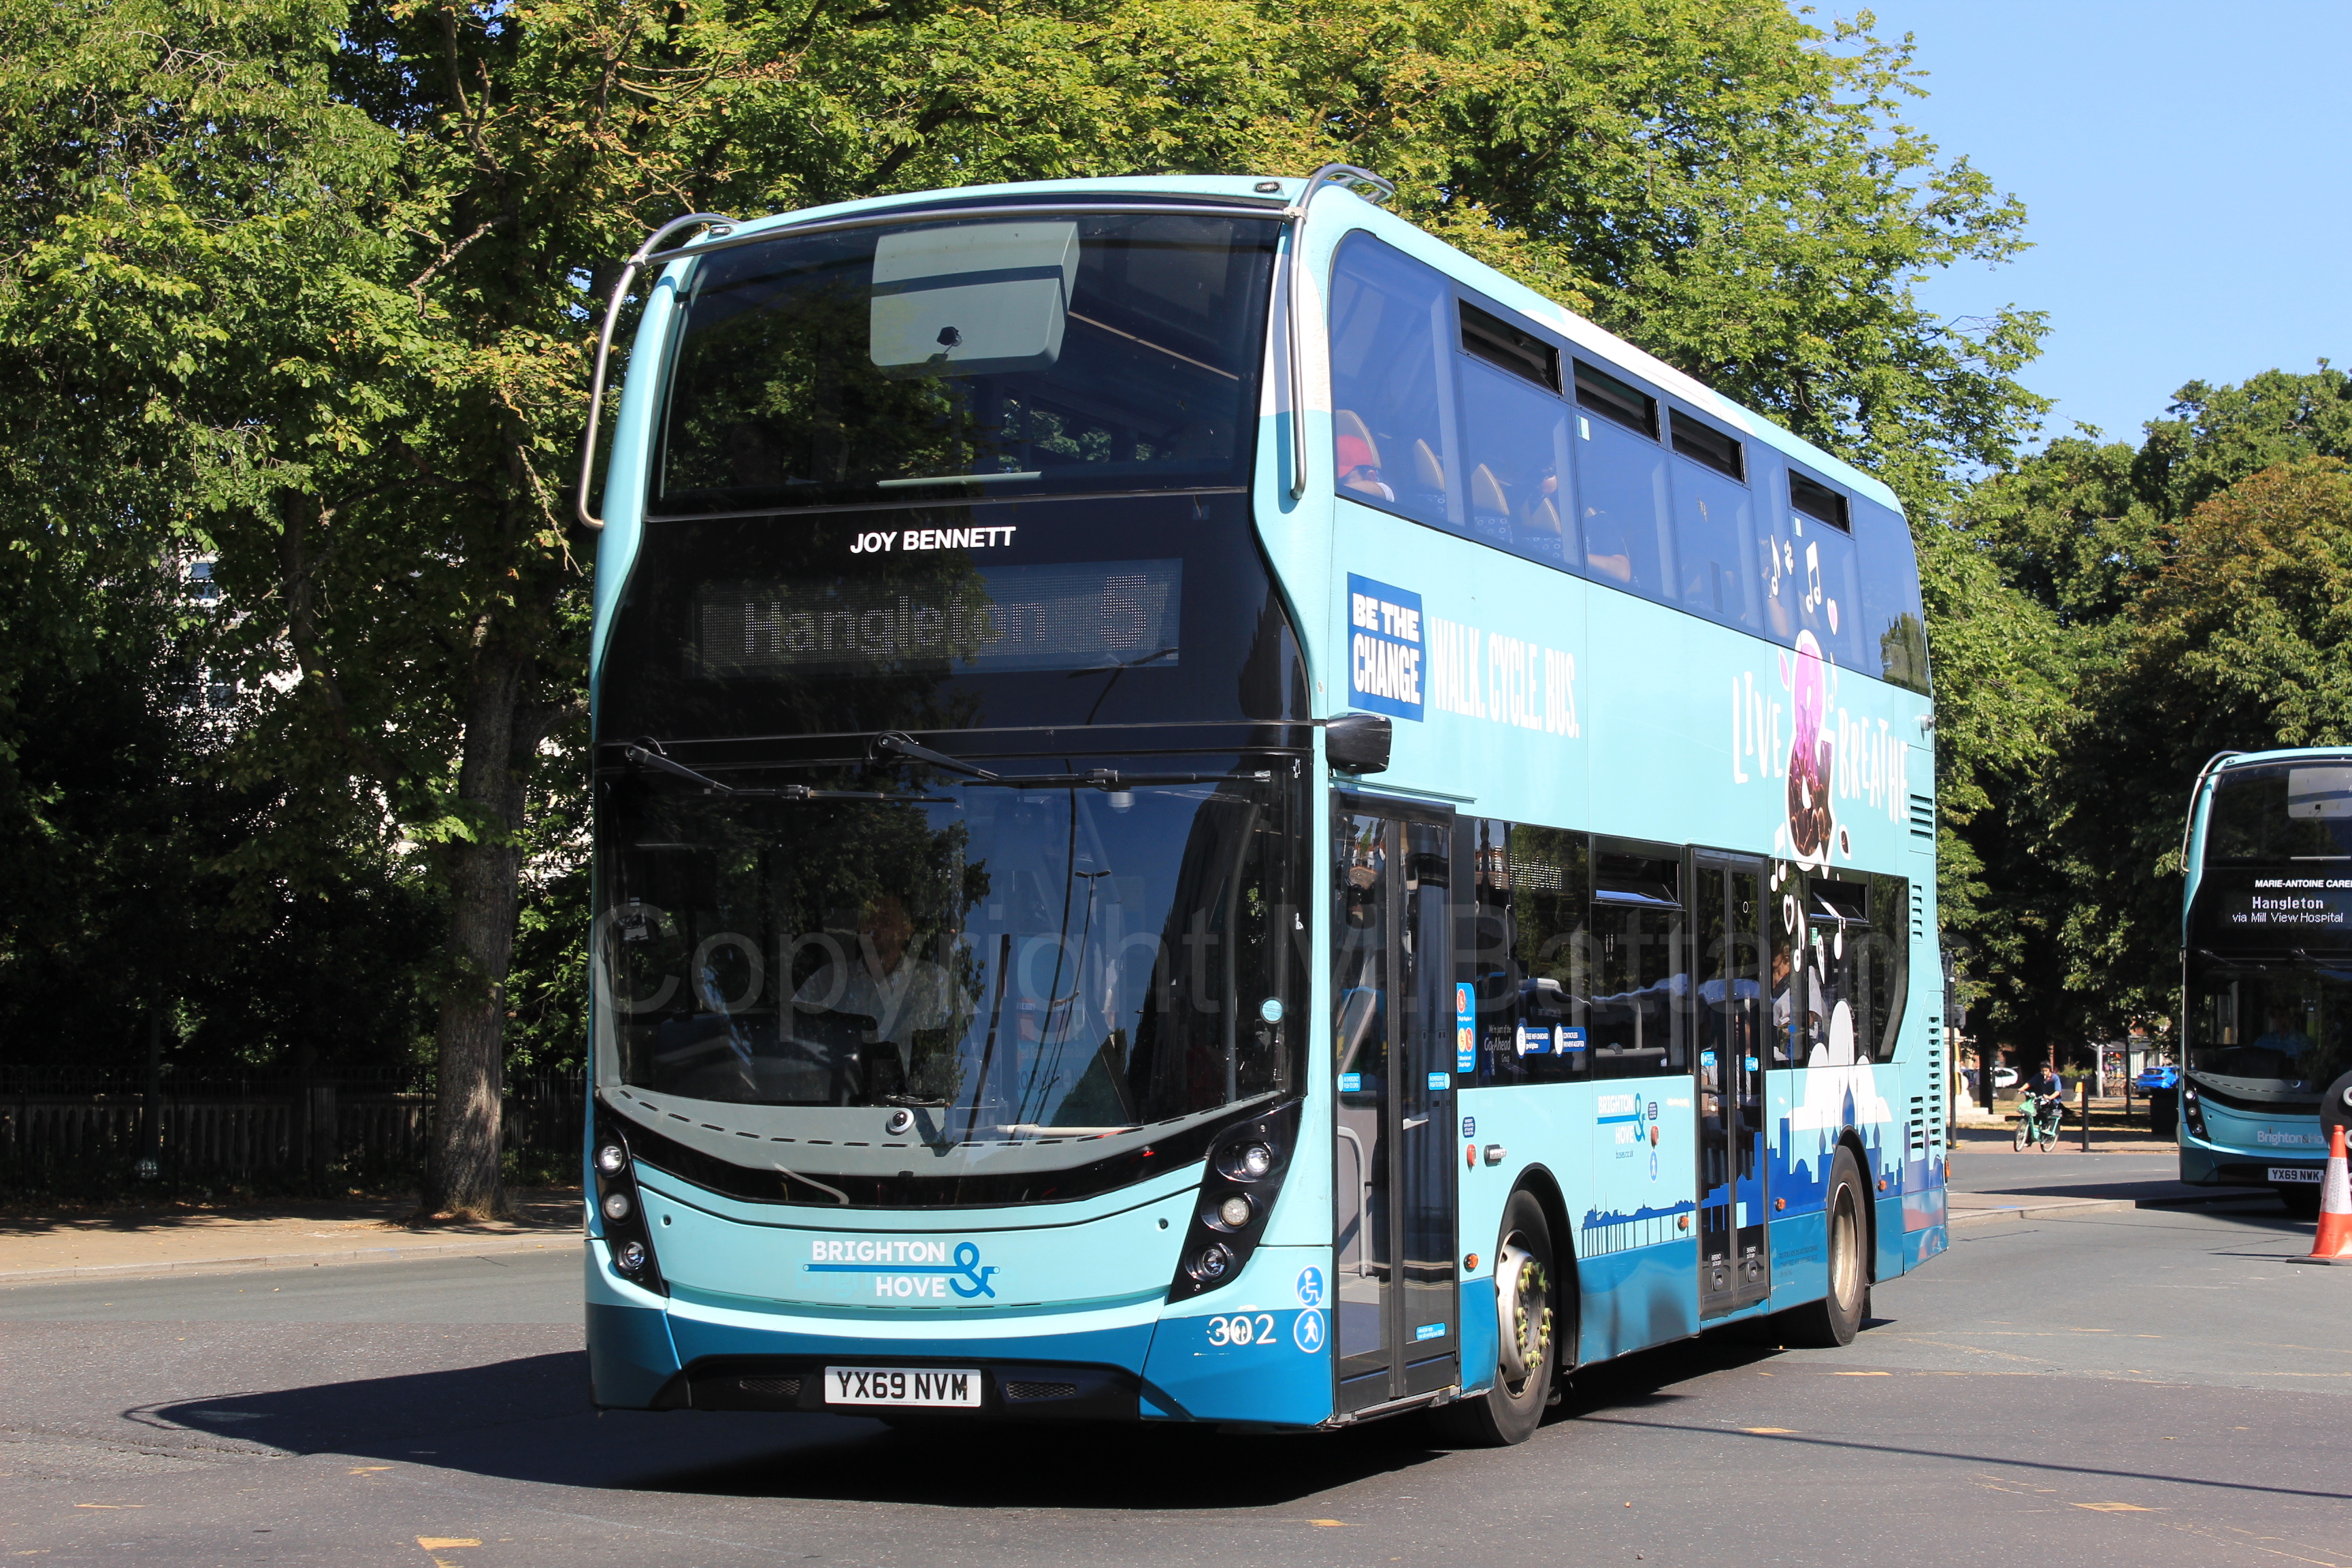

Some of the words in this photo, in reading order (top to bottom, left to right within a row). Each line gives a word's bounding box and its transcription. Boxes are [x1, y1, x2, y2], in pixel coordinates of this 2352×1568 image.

[850, 531, 896, 554] JOY
[902, 526, 1017, 551] BENNETT
[745, 594, 1045, 655] Hangleton
[1100, 575, 1146, 648] 5
[1352, 592, 1379, 632] BE
[1381, 601, 1420, 642] THE
[1353, 632, 1420, 705] CHANGE
[1431, 616, 1486, 719] WALK.
[1488, 632, 1542, 731] CYCLE.
[1545, 647, 1580, 739] BUS.
[1838, 707, 1909, 826] BREATHE
[2254, 879, 2325, 888] MARIE-ANTOINE
[2252, 896, 2324, 911] Hangleton
[2232, 912, 2247, 923] via
[2251, 912, 2267, 923] Mill
[2270, 912, 2299, 923] View
[2300, 912, 2344, 924] Hospital
[1484, 1036, 1511, 1051] Go-Ahead
[1598, 1094, 1633, 1114] BRIGHTON
[1615, 1125, 1634, 1145] HOVE
[2272, 1169, 2298, 1180] YX69
[2300, 1171, 2319, 1181] NWK
[812, 1240, 945, 1262] BRIGHTON
[875, 1276, 946, 1298] HOVE
[1208, 1313, 1277, 1346] 302
[837, 1371, 905, 1399] YX69
[915, 1373, 968, 1401] NVM
